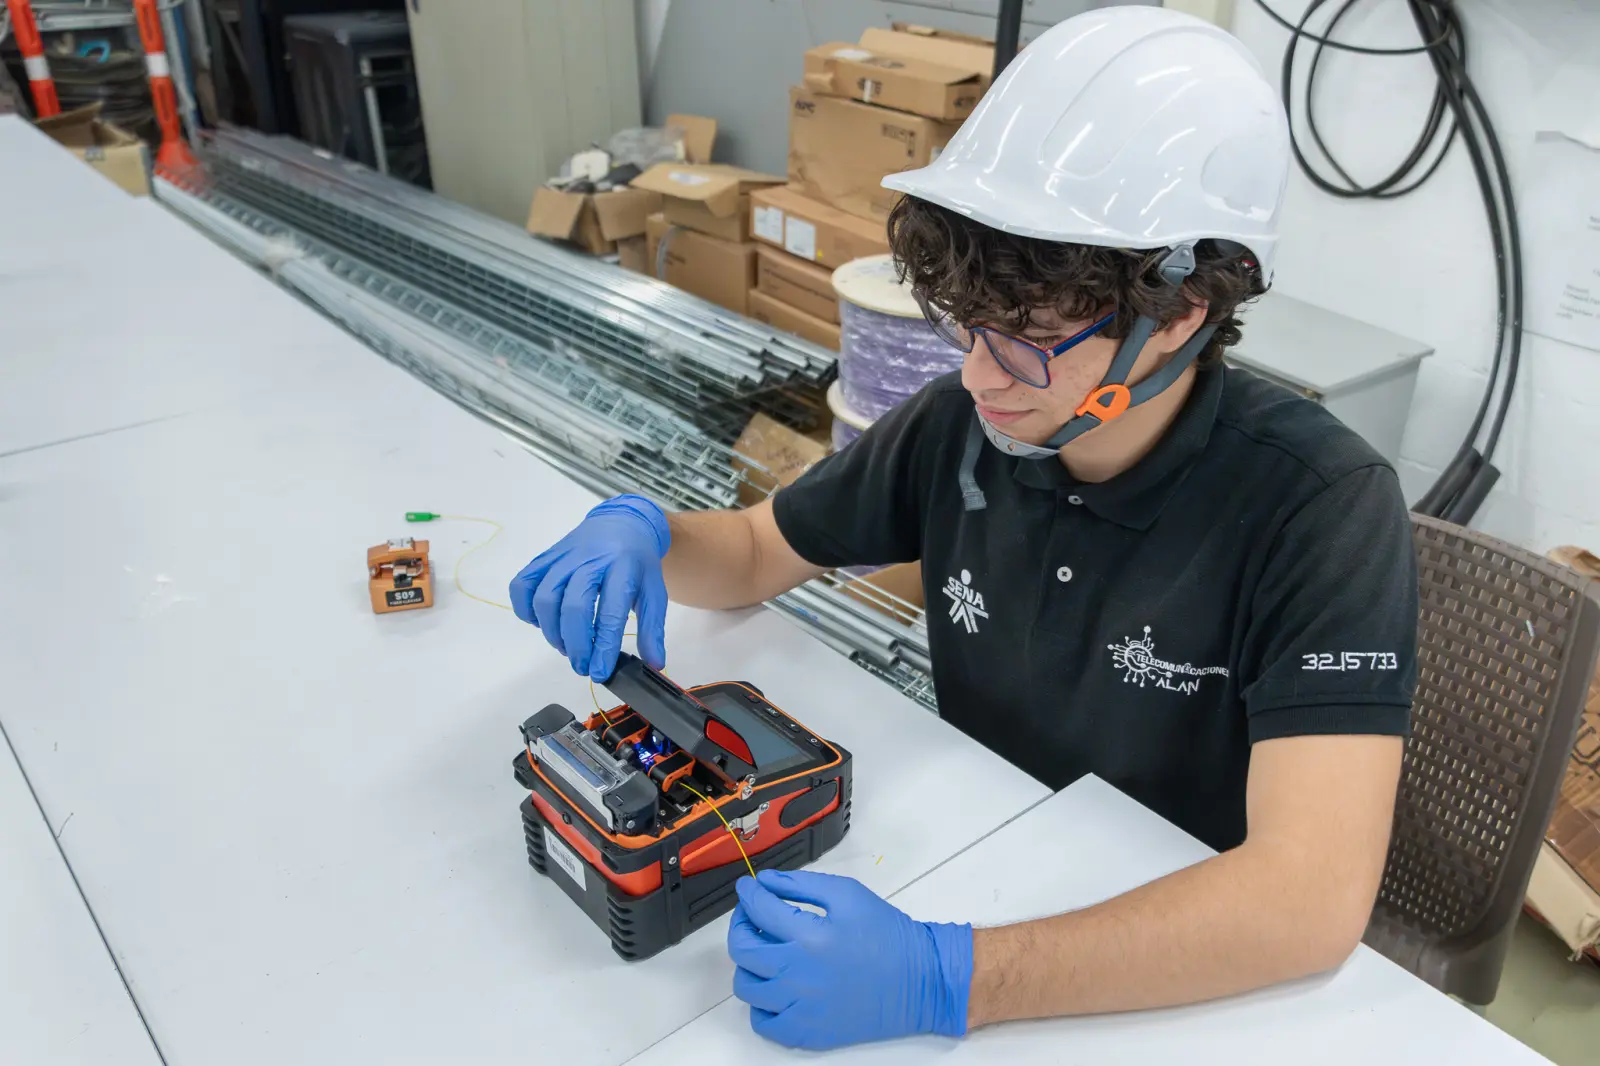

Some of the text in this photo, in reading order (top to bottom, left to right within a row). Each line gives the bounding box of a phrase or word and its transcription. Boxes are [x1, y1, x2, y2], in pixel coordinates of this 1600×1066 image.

[395, 590, 415, 600] S09
[947, 576, 984, 610] SENA
[1155, 676, 1200, 695] ALAN
